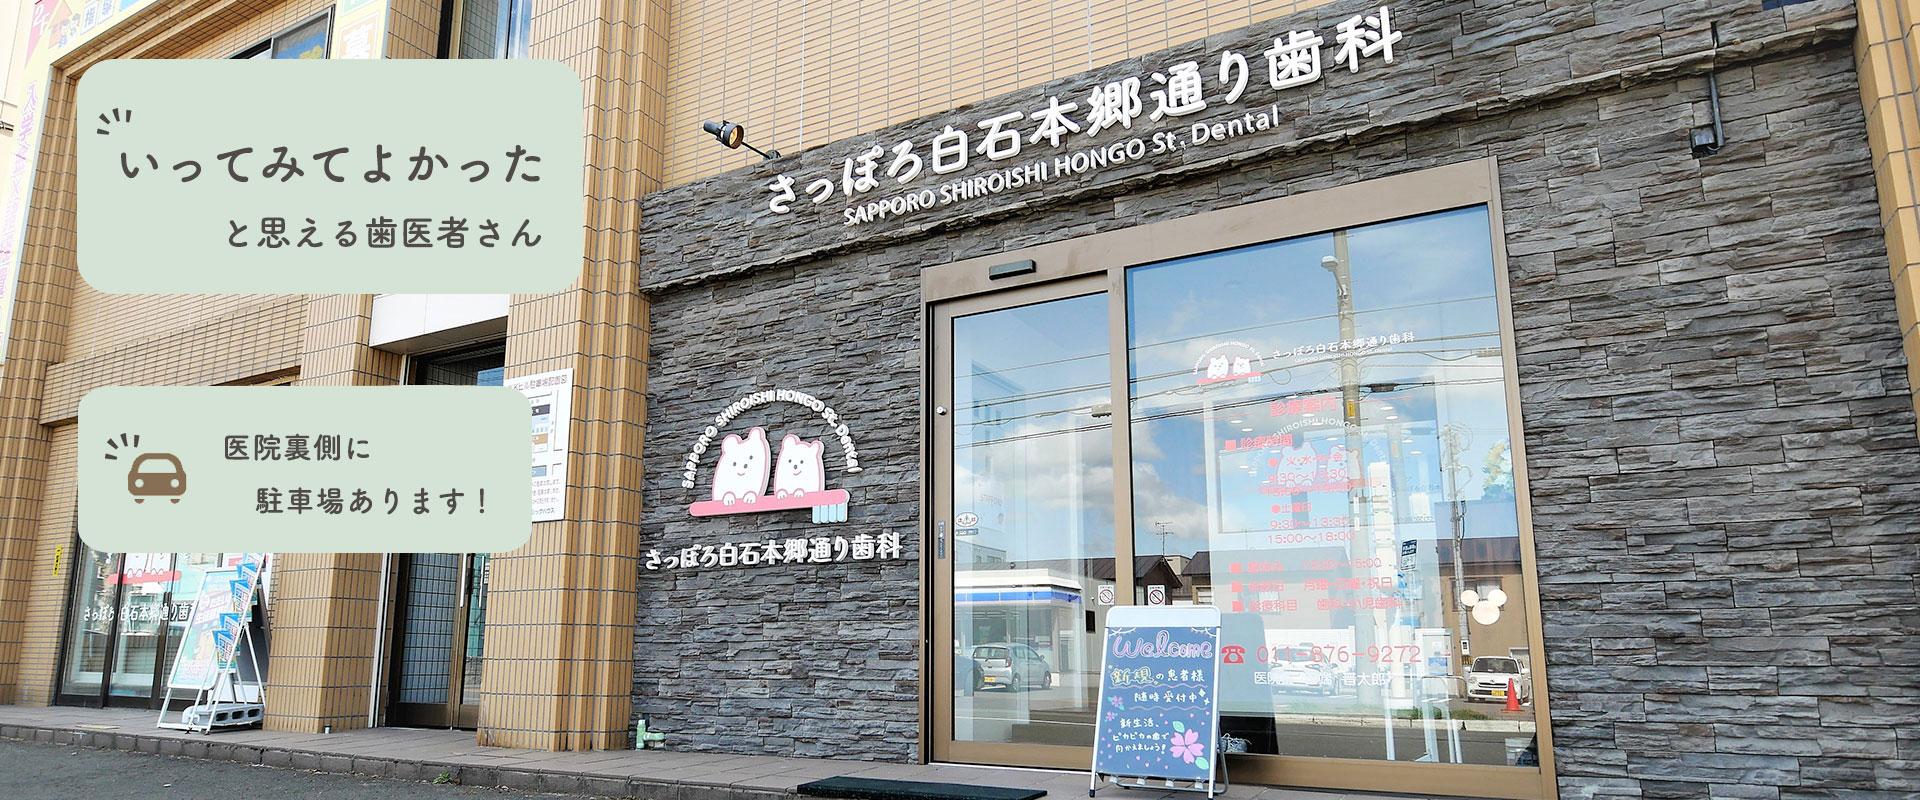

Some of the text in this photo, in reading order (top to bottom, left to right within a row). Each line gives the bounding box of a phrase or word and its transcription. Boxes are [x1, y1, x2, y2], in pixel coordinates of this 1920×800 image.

[768, 5, 1403, 216] さっぽろ白石本郷通り歯科
[843, 189, 936, 226] SAPPORO
[939, 160, 1048, 205] SHIROISHI
[1054, 137, 1146, 178] HONGO
[1191, 104, 1280, 146] Dental
[1272, 331, 1415, 360] さっぽろ白石本郷通り歯科
[681, 425, 718, 490] SAPPORO
[714, 389, 775, 428] SHIROISHI
[775, 388, 826, 413] HONGO
[835, 423, 863, 474] Dental
[645, 532, 903, 571] さっぽろ白石本郷通り歯科
[1256, 645, 1422, 664] 011-876-9272
[1134, 690, 1198, 704] 随時受付中
